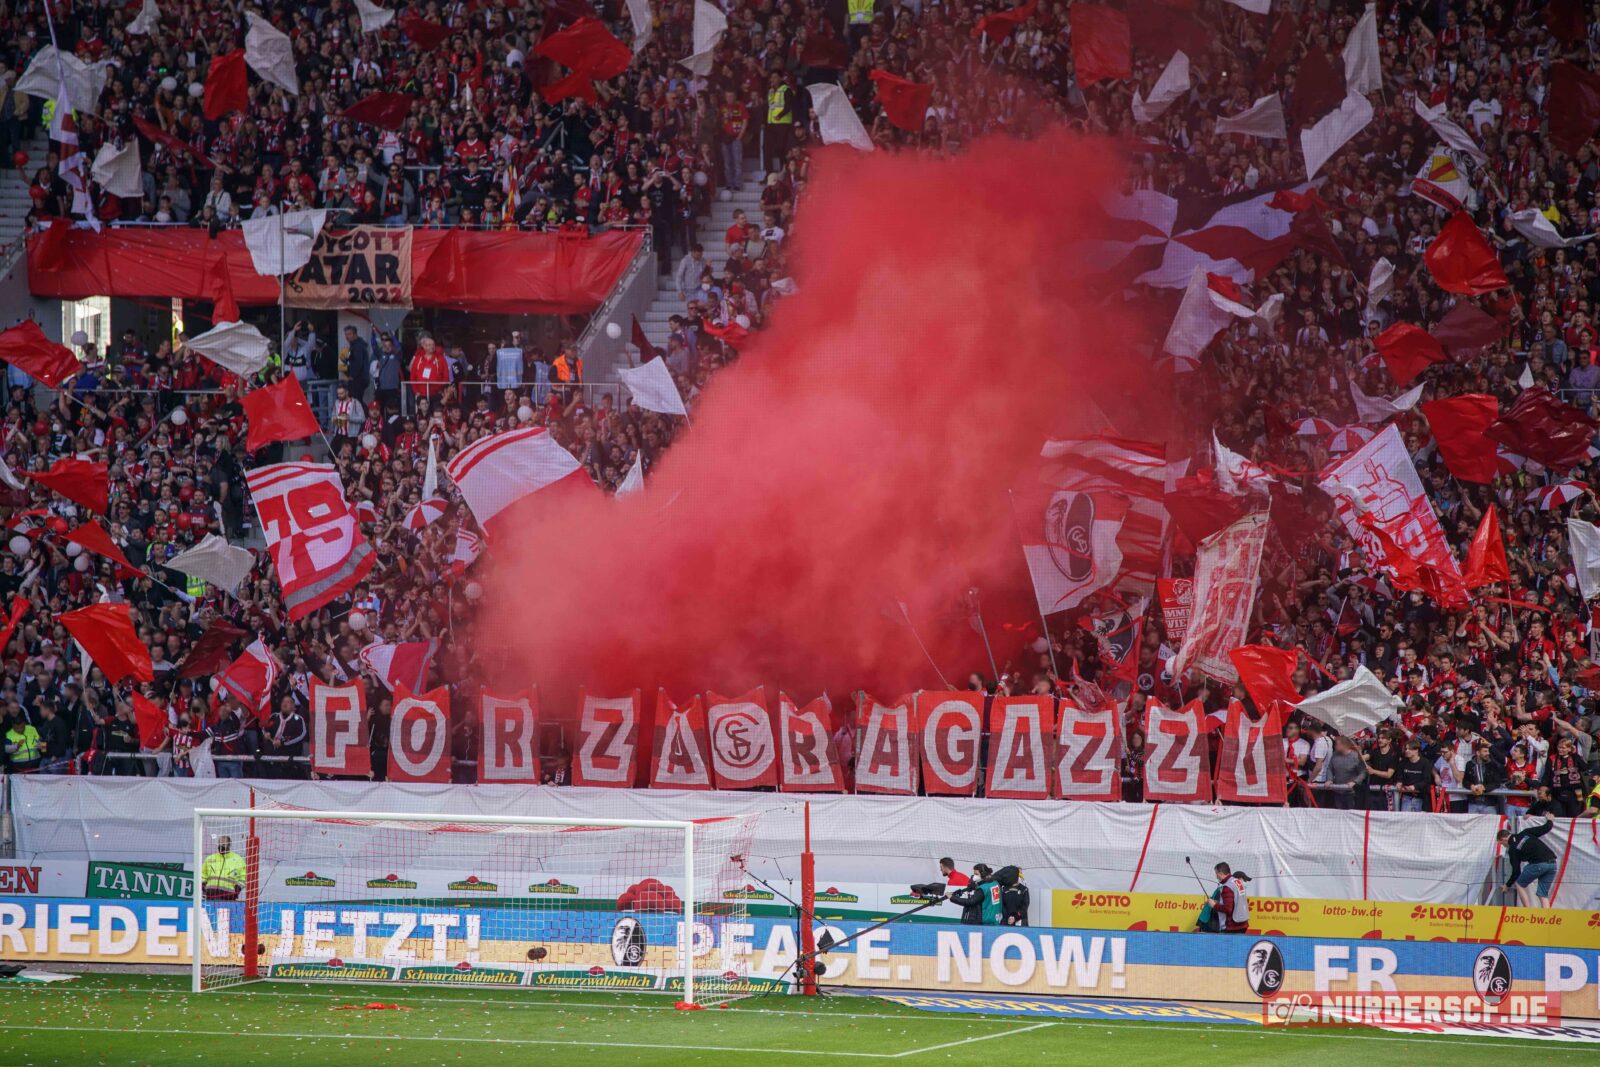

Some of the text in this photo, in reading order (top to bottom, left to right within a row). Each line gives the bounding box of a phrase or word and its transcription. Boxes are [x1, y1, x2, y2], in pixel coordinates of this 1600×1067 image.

[312, 230, 405, 253] OYCOTT
[298, 253, 401, 284] ATAR
[348, 287, 402, 304] 2022
[313, 684, 710, 785] FORZA
[780, 699, 1270, 797] RAGAZZI
[94, 866, 195, 899] TANNE
[1089, 894, 1131, 908] LOTTO
[1154, 899, 1205, 910] lotto-bw.
[1256, 900, 1300, 913] LOTTO
[1322, 905, 1383, 917] lotto-bw.de
[1429, 906, 1474, 921] LOTTO
[1503, 913, 1562, 925] otto-bw.de
[271, 909, 481, 962] JETZT!
[677, 921, 1127, 989] PEACE. NOW!
[276, 966, 389, 980] Schwarzwaldmilch
[405, 968, 518, 984] Schwarzwaldmilch
[536, 973, 650, 988] Schwarzwaldmilch
[1313, 944, 1400, 1001] FR
[669, 978, 783, 993] Scwarzwaldmilch
[1544, 952, 1600, 1010] P
